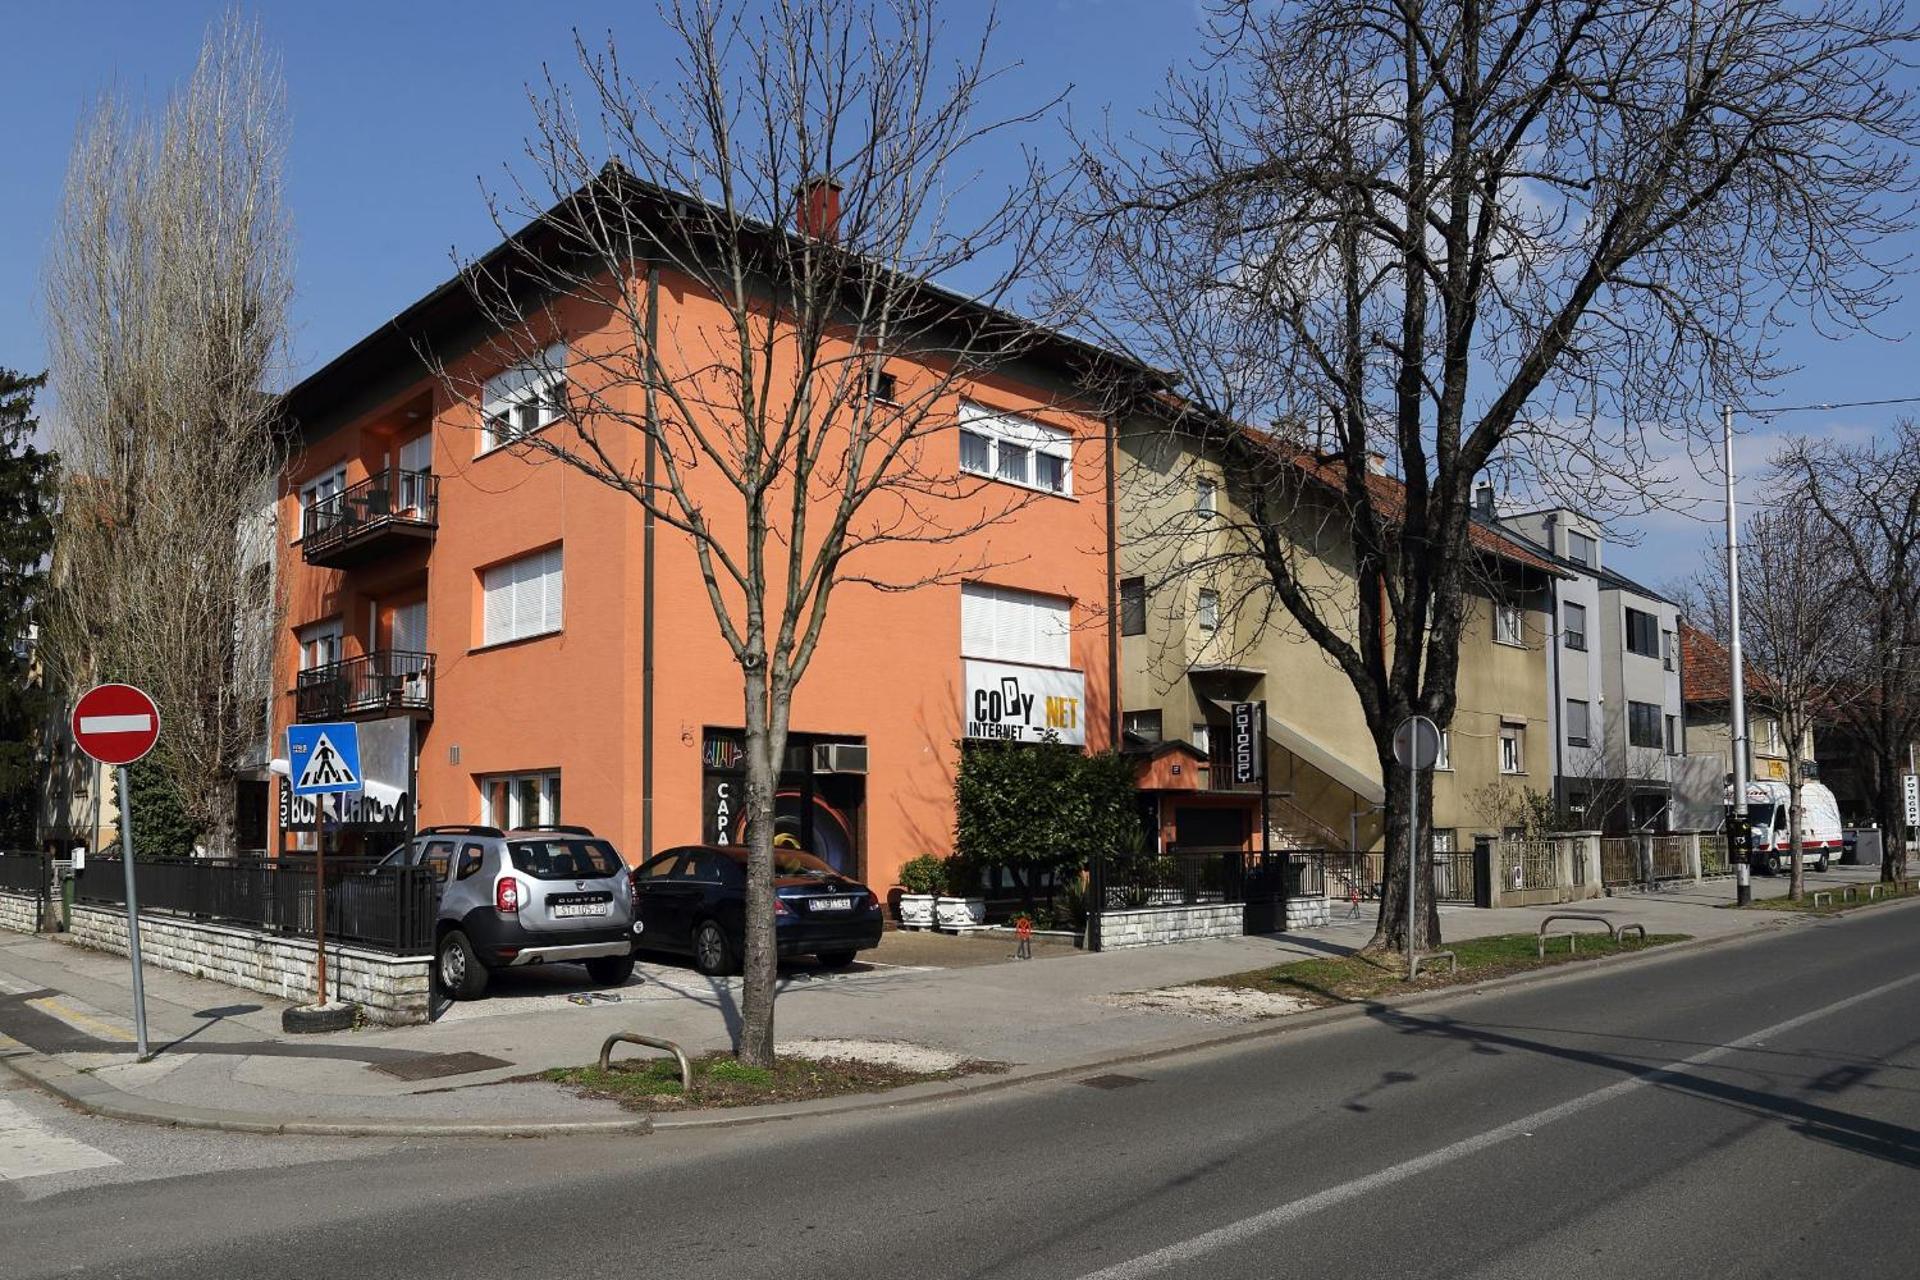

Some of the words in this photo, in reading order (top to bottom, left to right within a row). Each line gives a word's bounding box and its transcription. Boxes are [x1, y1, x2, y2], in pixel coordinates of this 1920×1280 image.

[974, 677, 1034, 725] COPY
[969, 721, 1024, 740] INTERNET
[1236, 704, 1250, 782] FOTOCOPY
[1907, 776, 1917, 825] FOTOCOPY
